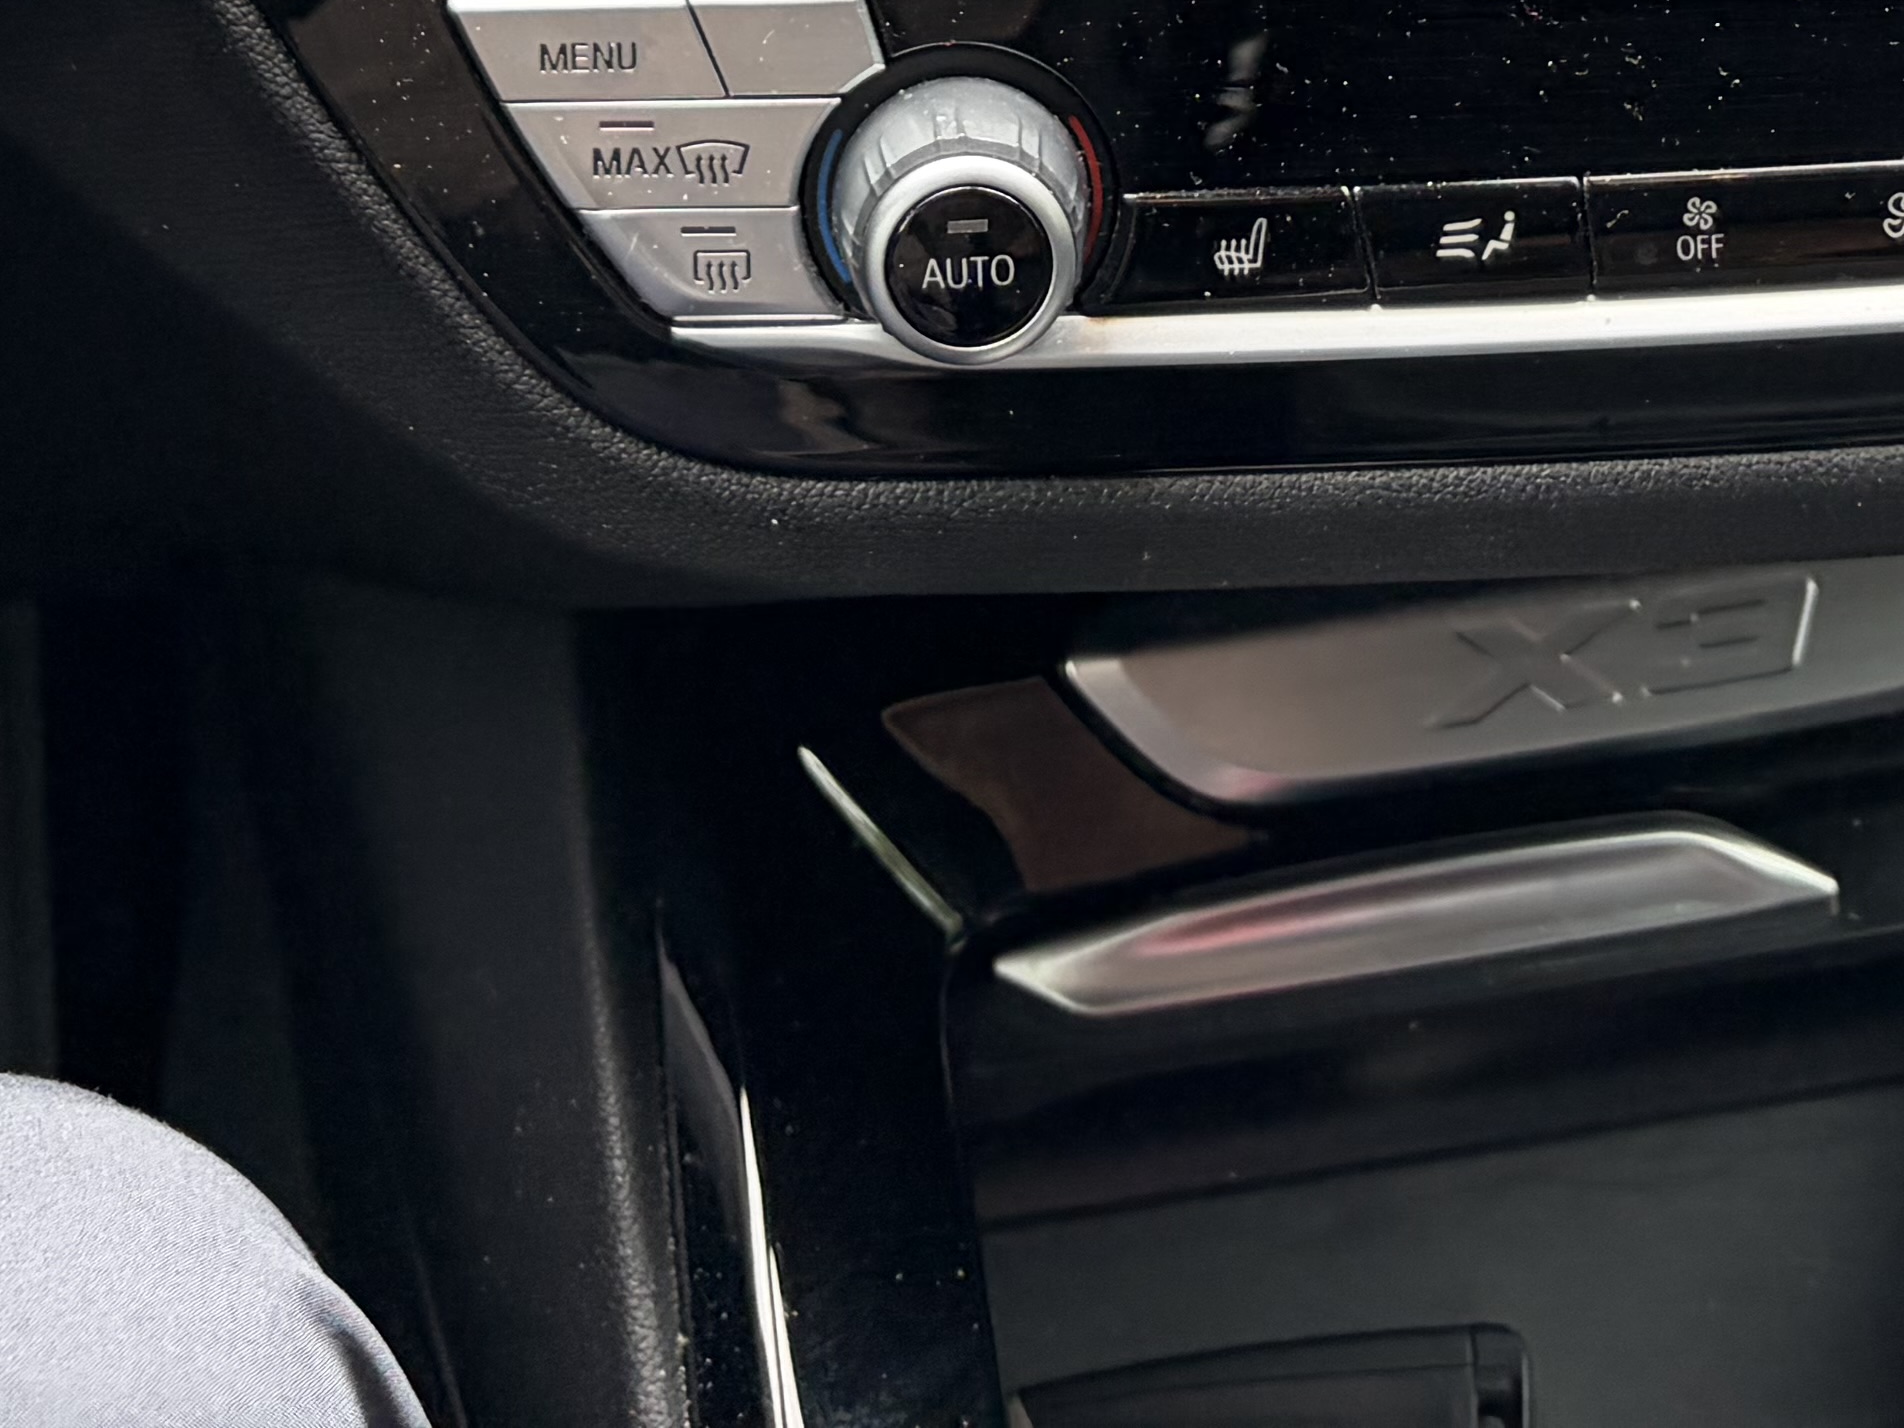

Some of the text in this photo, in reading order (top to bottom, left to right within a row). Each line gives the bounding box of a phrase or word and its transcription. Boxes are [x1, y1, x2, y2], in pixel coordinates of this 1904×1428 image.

[540, 42, 637, 74] MENU
[594, 148, 674, 178] MAX
[1676, 233, 1725, 261] OFF
[922, 255, 1015, 289] AUTO
[1423, 576, 1821, 730] X3
